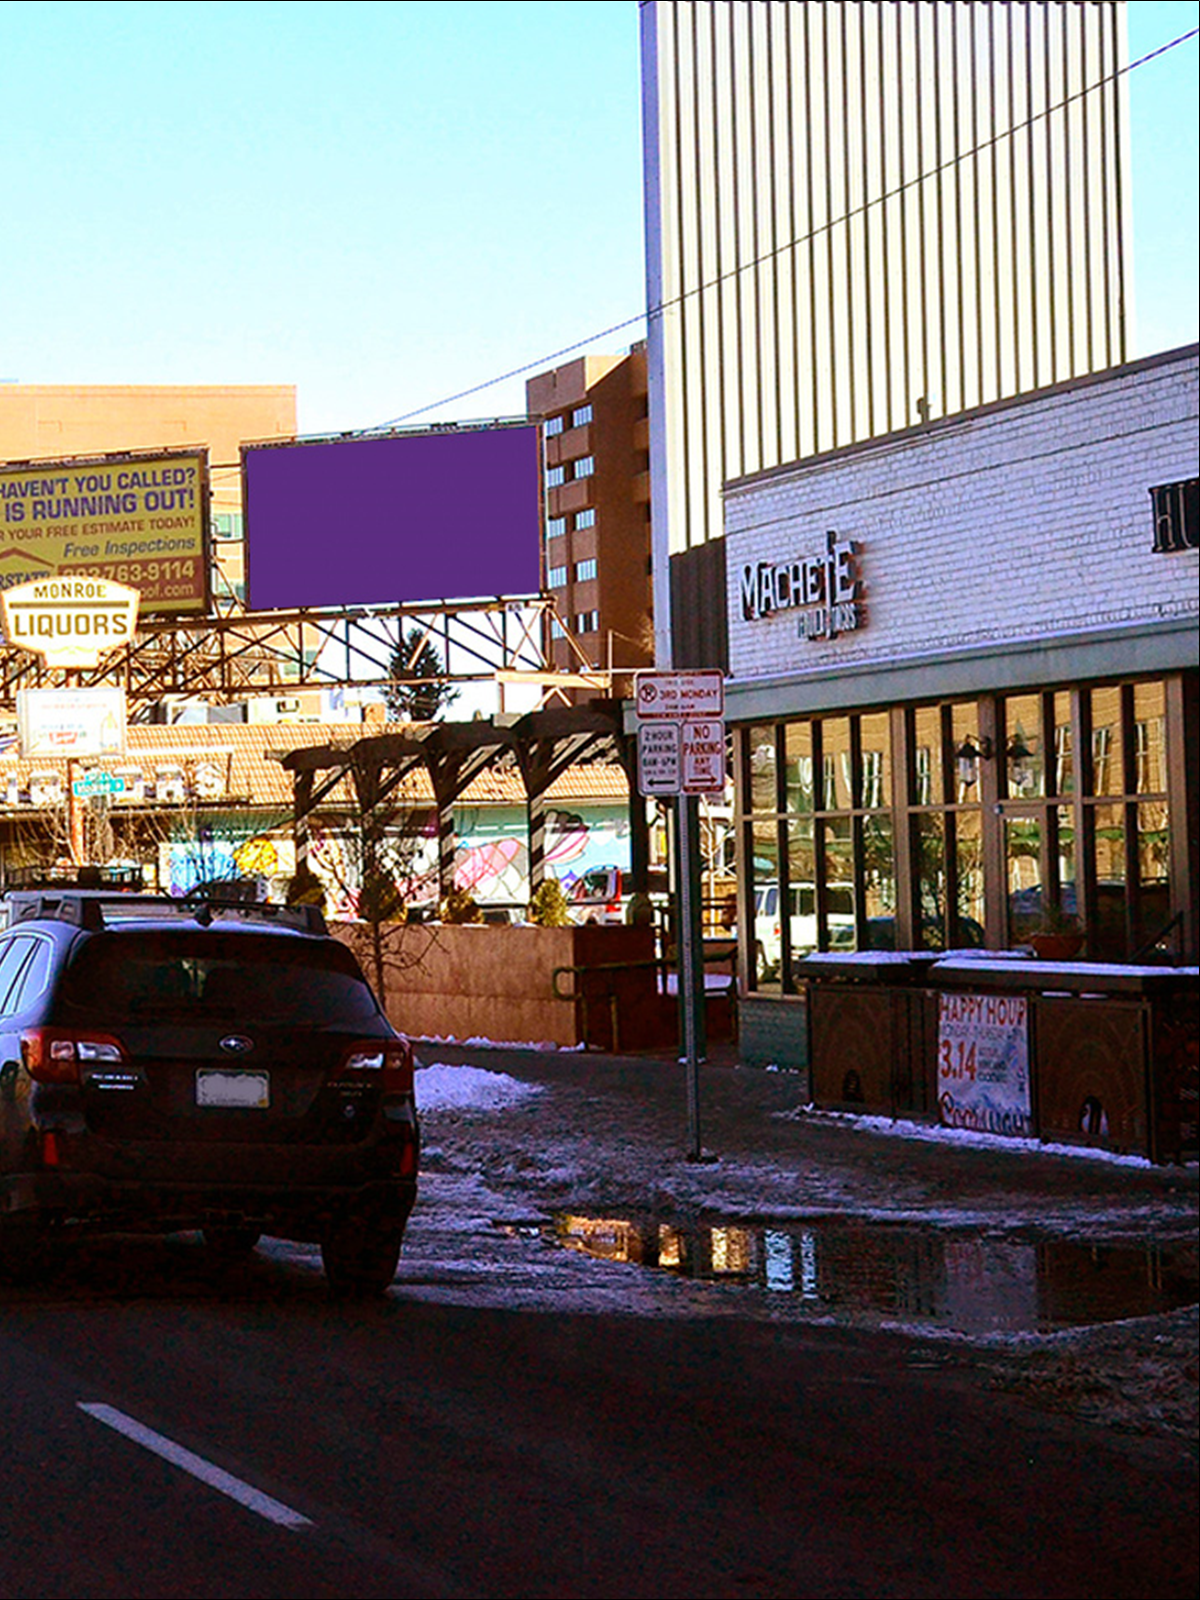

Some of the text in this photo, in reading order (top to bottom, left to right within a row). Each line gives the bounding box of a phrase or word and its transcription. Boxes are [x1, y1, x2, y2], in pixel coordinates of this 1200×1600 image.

[75, 475, 111, 494] YOU
[117, 467, 195, 489] CALLED?
[5, 501, 25, 523] IS
[32, 493, 136, 520] RUNNING
[145, 488, 195, 512] OUT!
[9, 527, 43, 541] YOUR
[46, 524, 79, 538] FREE
[82, 519, 145, 535] ESTIMATE
[149, 516, 195, 531] TODAY!
[63, 536, 195, 559] Free Inspections
[34, 583, 107, 598] MONROE
[14, 613, 128, 638] LIQUORS
[681, 689, 718, 699] MONDAY
[694, 725, 710, 739] NO
[643, 744, 676, 754] PARKING
[683, 742, 722, 755] PARKING
[695, 758, 711, 766] ANY
[940, 997, 1027, 1027] HAPPY HOUR
[941, 1040, 977, 1081] 3.14
